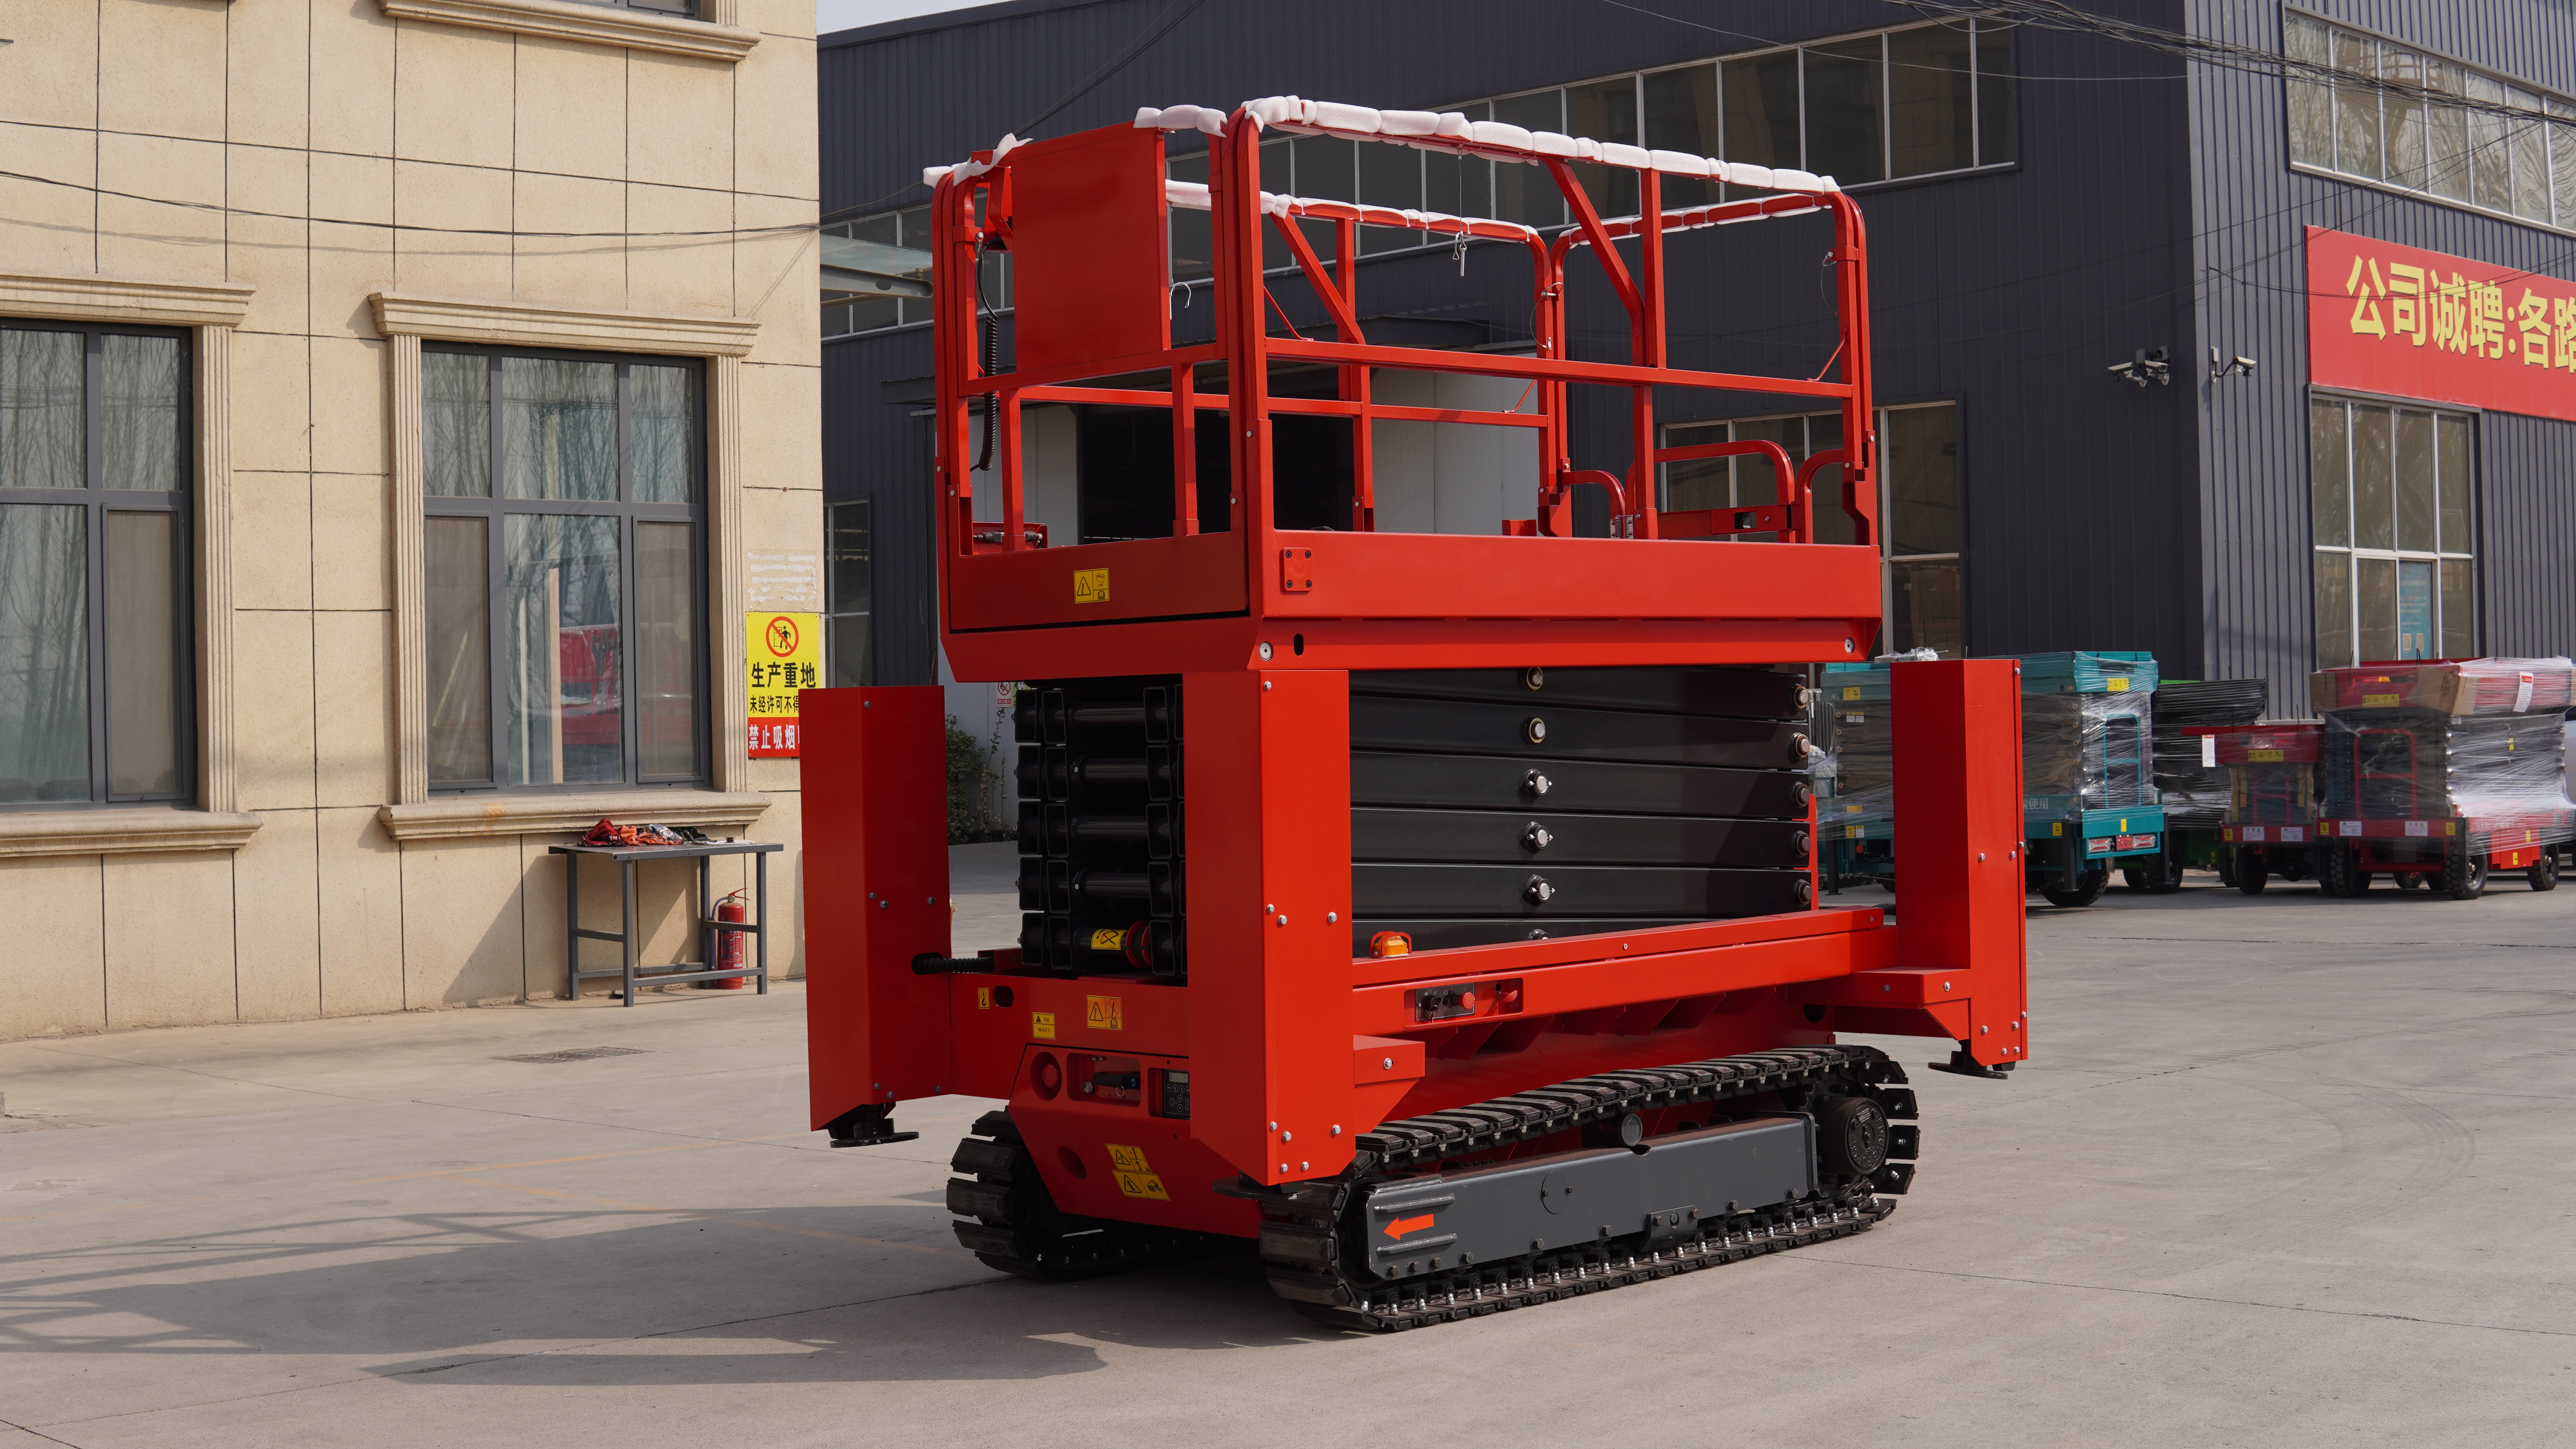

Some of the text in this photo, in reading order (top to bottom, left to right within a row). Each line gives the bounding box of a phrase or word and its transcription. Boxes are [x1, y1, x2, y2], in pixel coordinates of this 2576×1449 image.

[751, 661, 817, 688] 生产重地
[750, 694, 799, 713] 未经许可不得
[749, 724, 800, 751] 禁止吸烟
